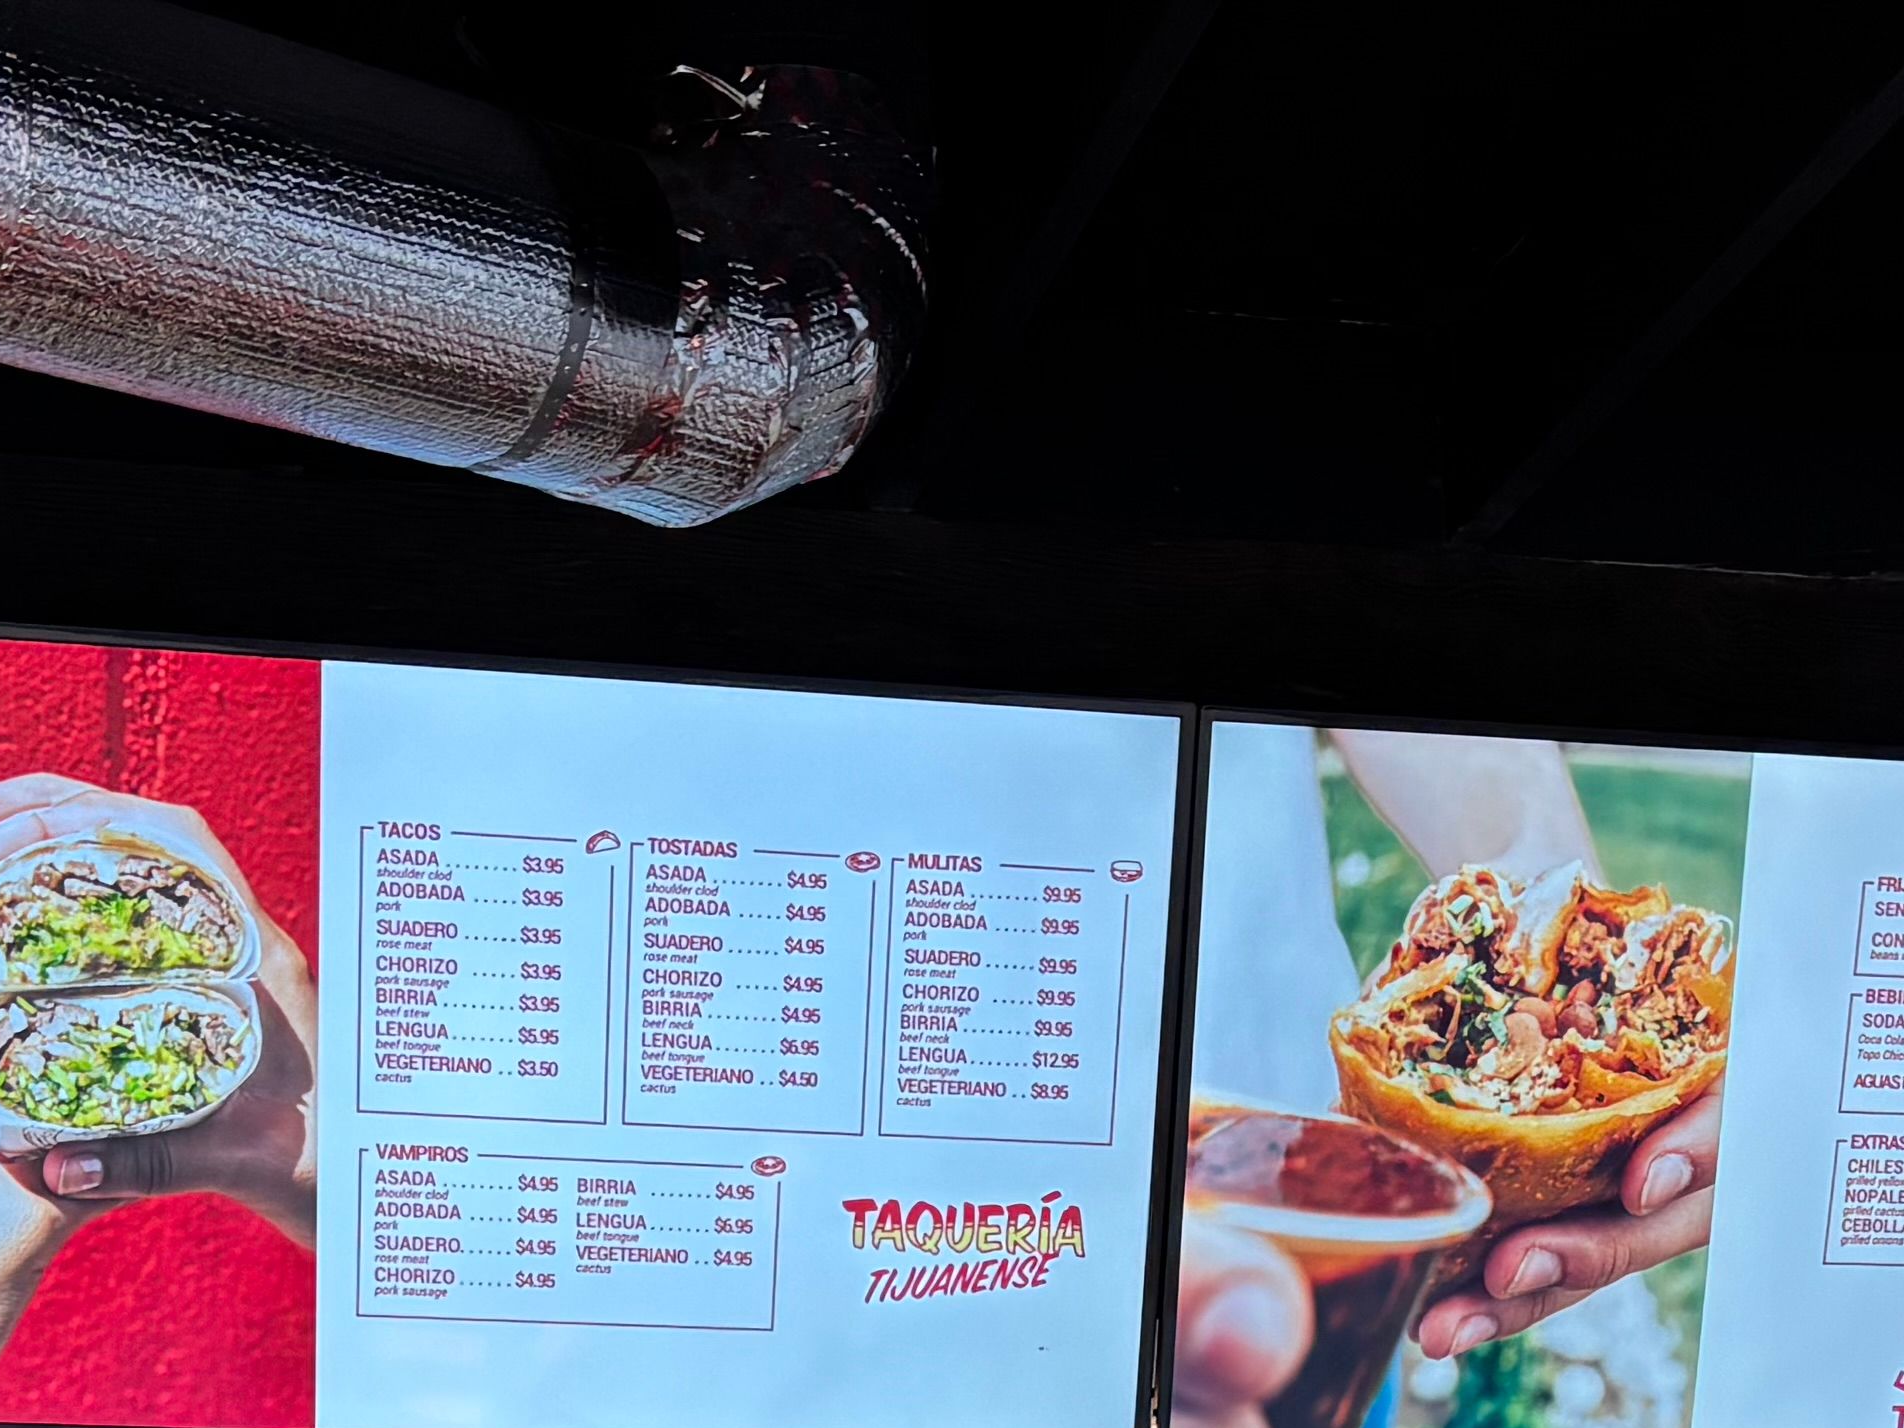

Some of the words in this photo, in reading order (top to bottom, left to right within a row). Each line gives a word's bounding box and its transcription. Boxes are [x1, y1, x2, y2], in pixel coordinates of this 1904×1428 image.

[378, 821, 441, 840] TACOS
[648, 838, 737, 858] TOSTADAS
[377, 848, 439, 867] ASADA
[522, 855, 564, 874] $3.95
[908, 853, 982, 872] MULITAS
[906, 879, 964, 897] ASADA
[645, 897, 730, 916] ADOBADA
[786, 903, 826, 922] $4.95
[376, 919, 458, 939] SUADERO
[520, 926, 561, 945] $3.95
[375, 1021, 449, 1039] LENGUA
[519, 1026, 559, 1045] $5.95
[375, 1053, 492, 1074] VEGETERIANO
[518, 1059, 558, 1077] $3.50
[899, 1046, 967, 1064] LENGUA
[376, 1143, 469, 1163] VAMPIROS
[1847, 1159, 1904, 1175] CHILES
[577, 1178, 636, 1195] BIRRIA
[716, 1182, 755, 1200] $4.95
[374, 1202, 461, 1220] ADOBADA
[517, 1206, 558, 1224] $4.95
[842, 1190, 1085, 1258] TAQUERÍA
[865, 1251, 1059, 1304] TIJUANENSE
